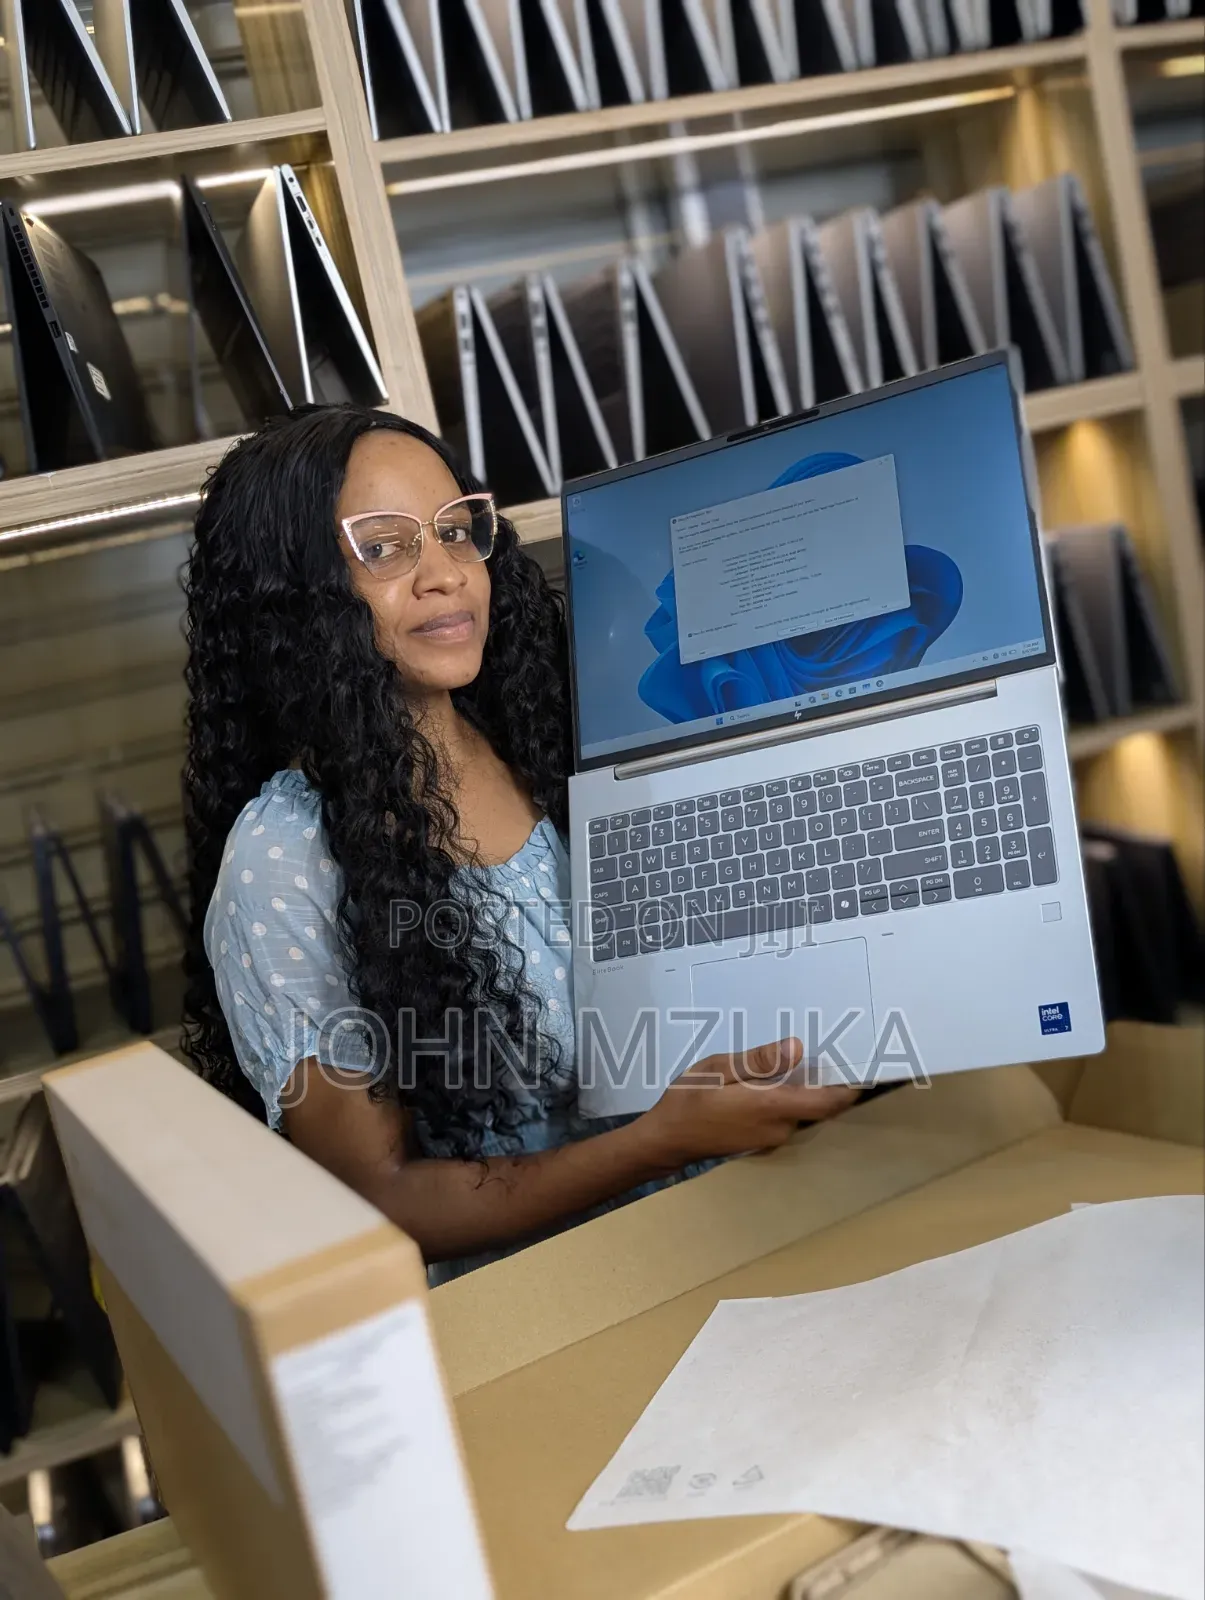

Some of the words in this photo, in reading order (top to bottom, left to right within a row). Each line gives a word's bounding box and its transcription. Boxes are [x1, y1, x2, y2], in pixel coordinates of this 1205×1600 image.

[899, 775, 934, 786] BACKSPACE
[1004, 786, 1010, 795] 9
[978, 791, 984, 799] 8
[801, 800, 807, 808] 9
[953, 796, 958, 805] 7
[777, 804, 782, 813] 8
[728, 814, 734, 822] 6
[1007, 813, 1013, 822] 6
[705, 820, 710, 828] 5
[841, 818, 847, 826] P
[981, 818, 987, 826] 5
[815, 823, 823, 831] O
[956, 823, 962, 831] 4
[659, 829, 664, 837] 3
[766, 832, 772, 841] U
[919, 828, 940, 837] ENTER
[636, 834, 641, 842] 2
[742, 837, 748, 845] Y
[718, 842, 724, 850] T
[1011, 841, 1016, 849] 3
[694, 847, 700, 855] R
[985, 846, 990, 854] 2
[646, 856, 656, 864] W
[671, 852, 676, 860] E
[799, 852, 805, 861] K
[925, 855, 942, 863] SHIFT
[750, 862, 756, 870] H
[775, 858, 780, 866] J
[702, 871, 707, 879] F
[725, 867, 732, 875] G
[655, 880, 661, 888] S
[678, 876, 684, 884] D
[632, 885, 639, 893] A
[788, 881, 796, 890] M
[739, 890, 746, 898] B
[764, 886, 770, 894] N
[715, 894, 722, 902] V
[645, 908, 651, 916] Z
[1042, 1006, 1059, 1016] intel
